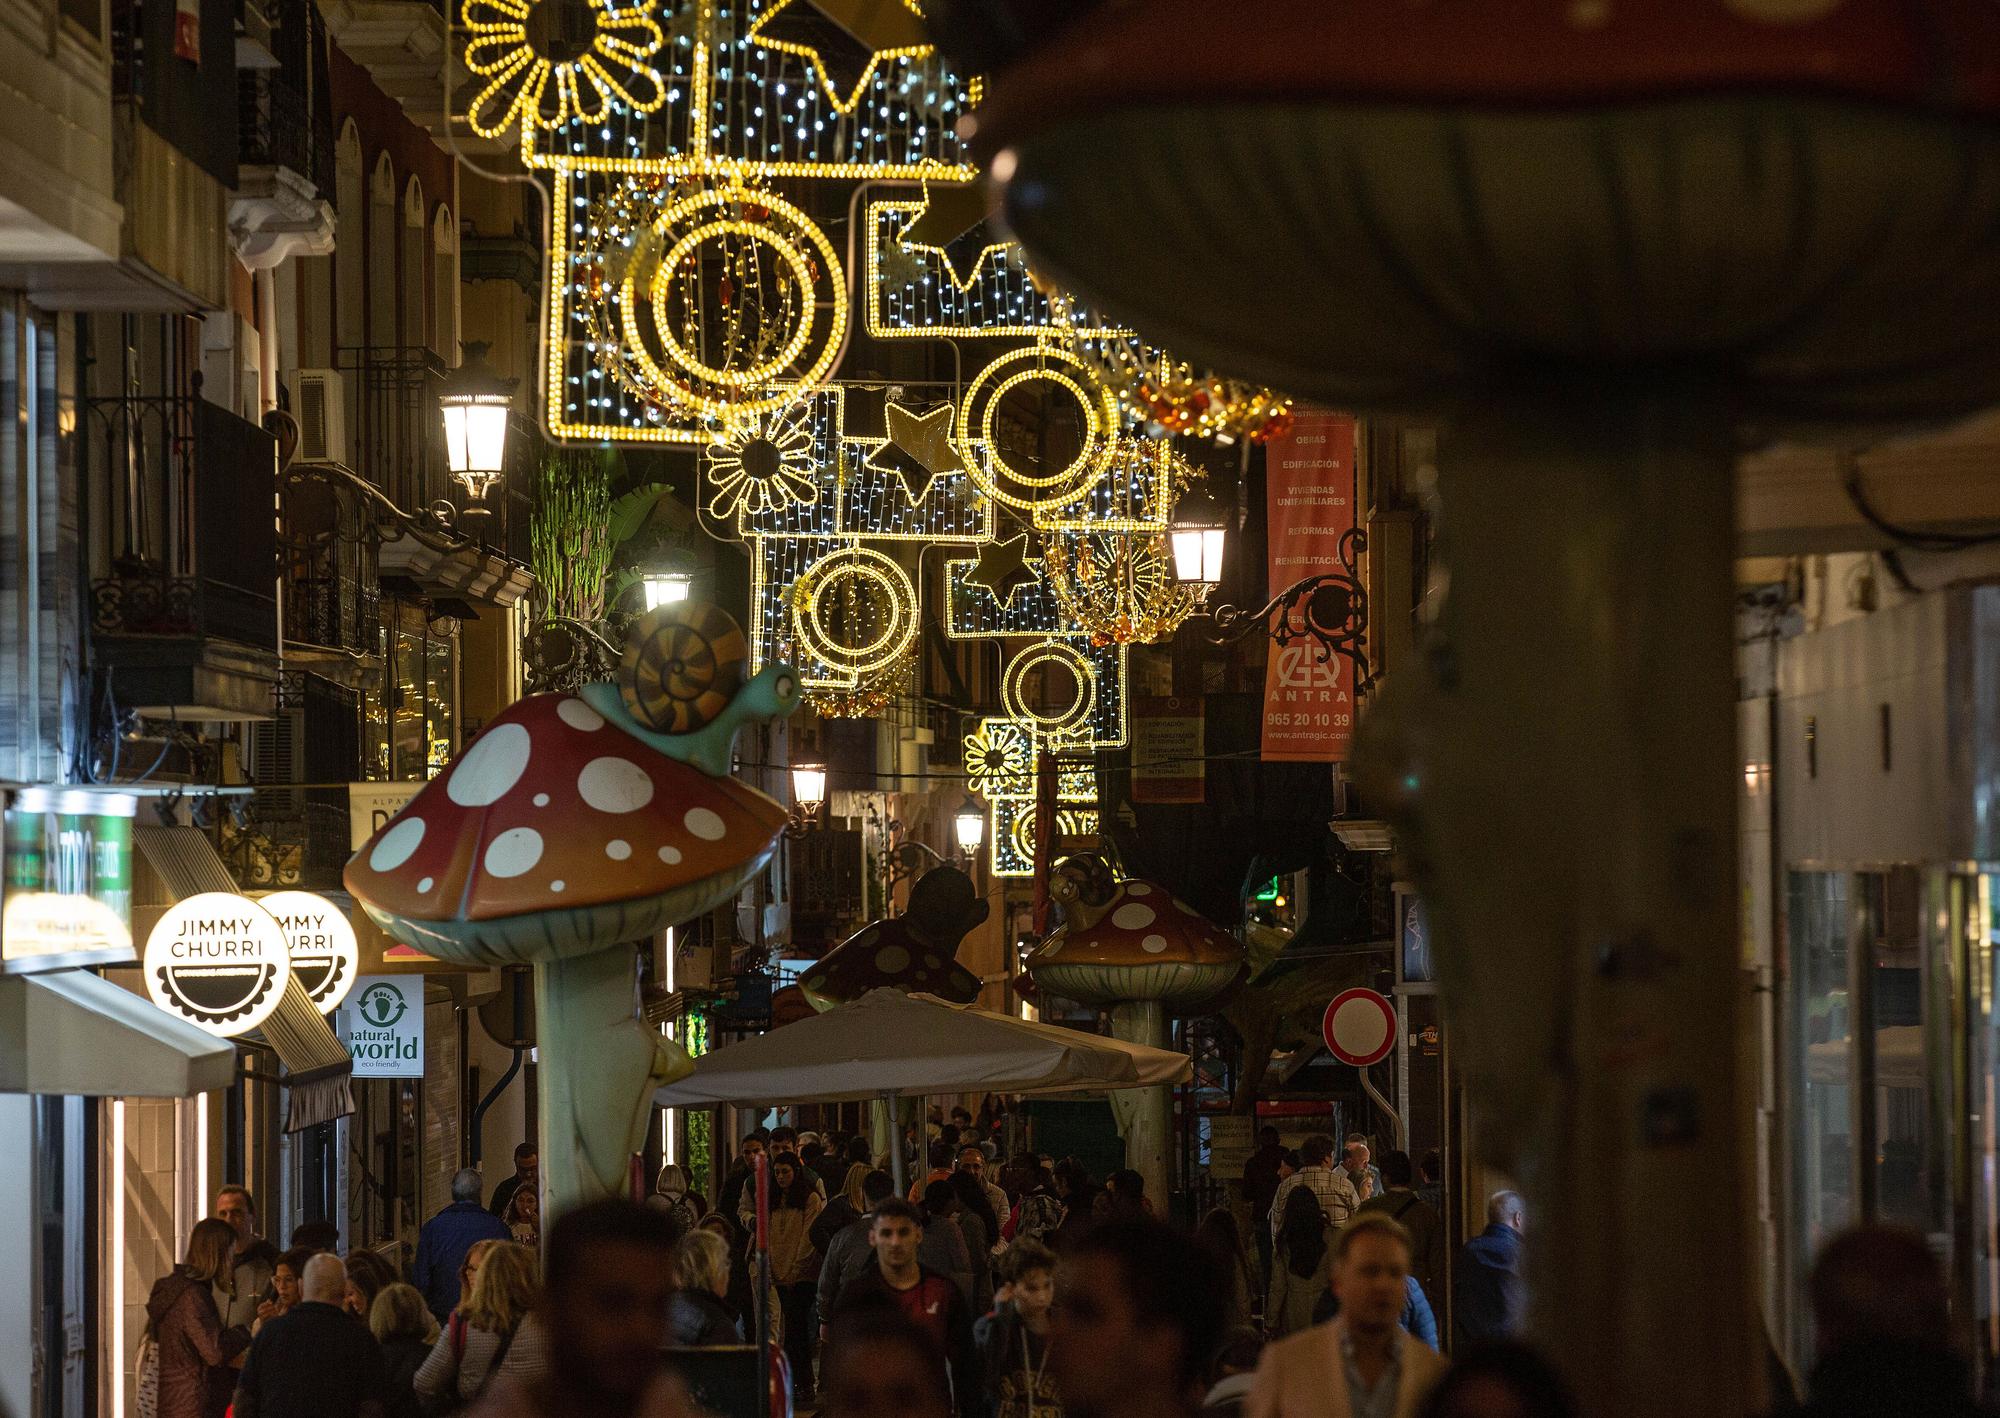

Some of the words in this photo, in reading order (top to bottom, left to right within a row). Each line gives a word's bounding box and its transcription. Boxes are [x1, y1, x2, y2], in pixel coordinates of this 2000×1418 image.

[1296, 435, 1327, 444] OBRAS
[1282, 459, 1340, 469] EDIFICACIÓN
[1288, 486, 1335, 495] VIVIENDAS
[1277, 497, 1346, 506] UNIFAMILIARES
[1288, 527, 1335, 536] REFORMAS
[1270, 690, 1348, 702] ANTRA
[1267, 713, 1290, 725] 965
[1294, 713, 1310, 725] 20
[1314, 713, 1330, 726] 10
[1334, 714, 1350, 726] 39
[1267, 731, 1350, 741] www.antragic.com
[372, 809, 398, 835] D
[178, 918, 253, 937] JIMMY
[274, 914, 325, 930] MMY
[288, 934, 333, 950] URRI
[171, 940, 262, 958] CHURRI
[350, 1036, 418, 1059] world
[375, 1060, 401, 1069] friendly
